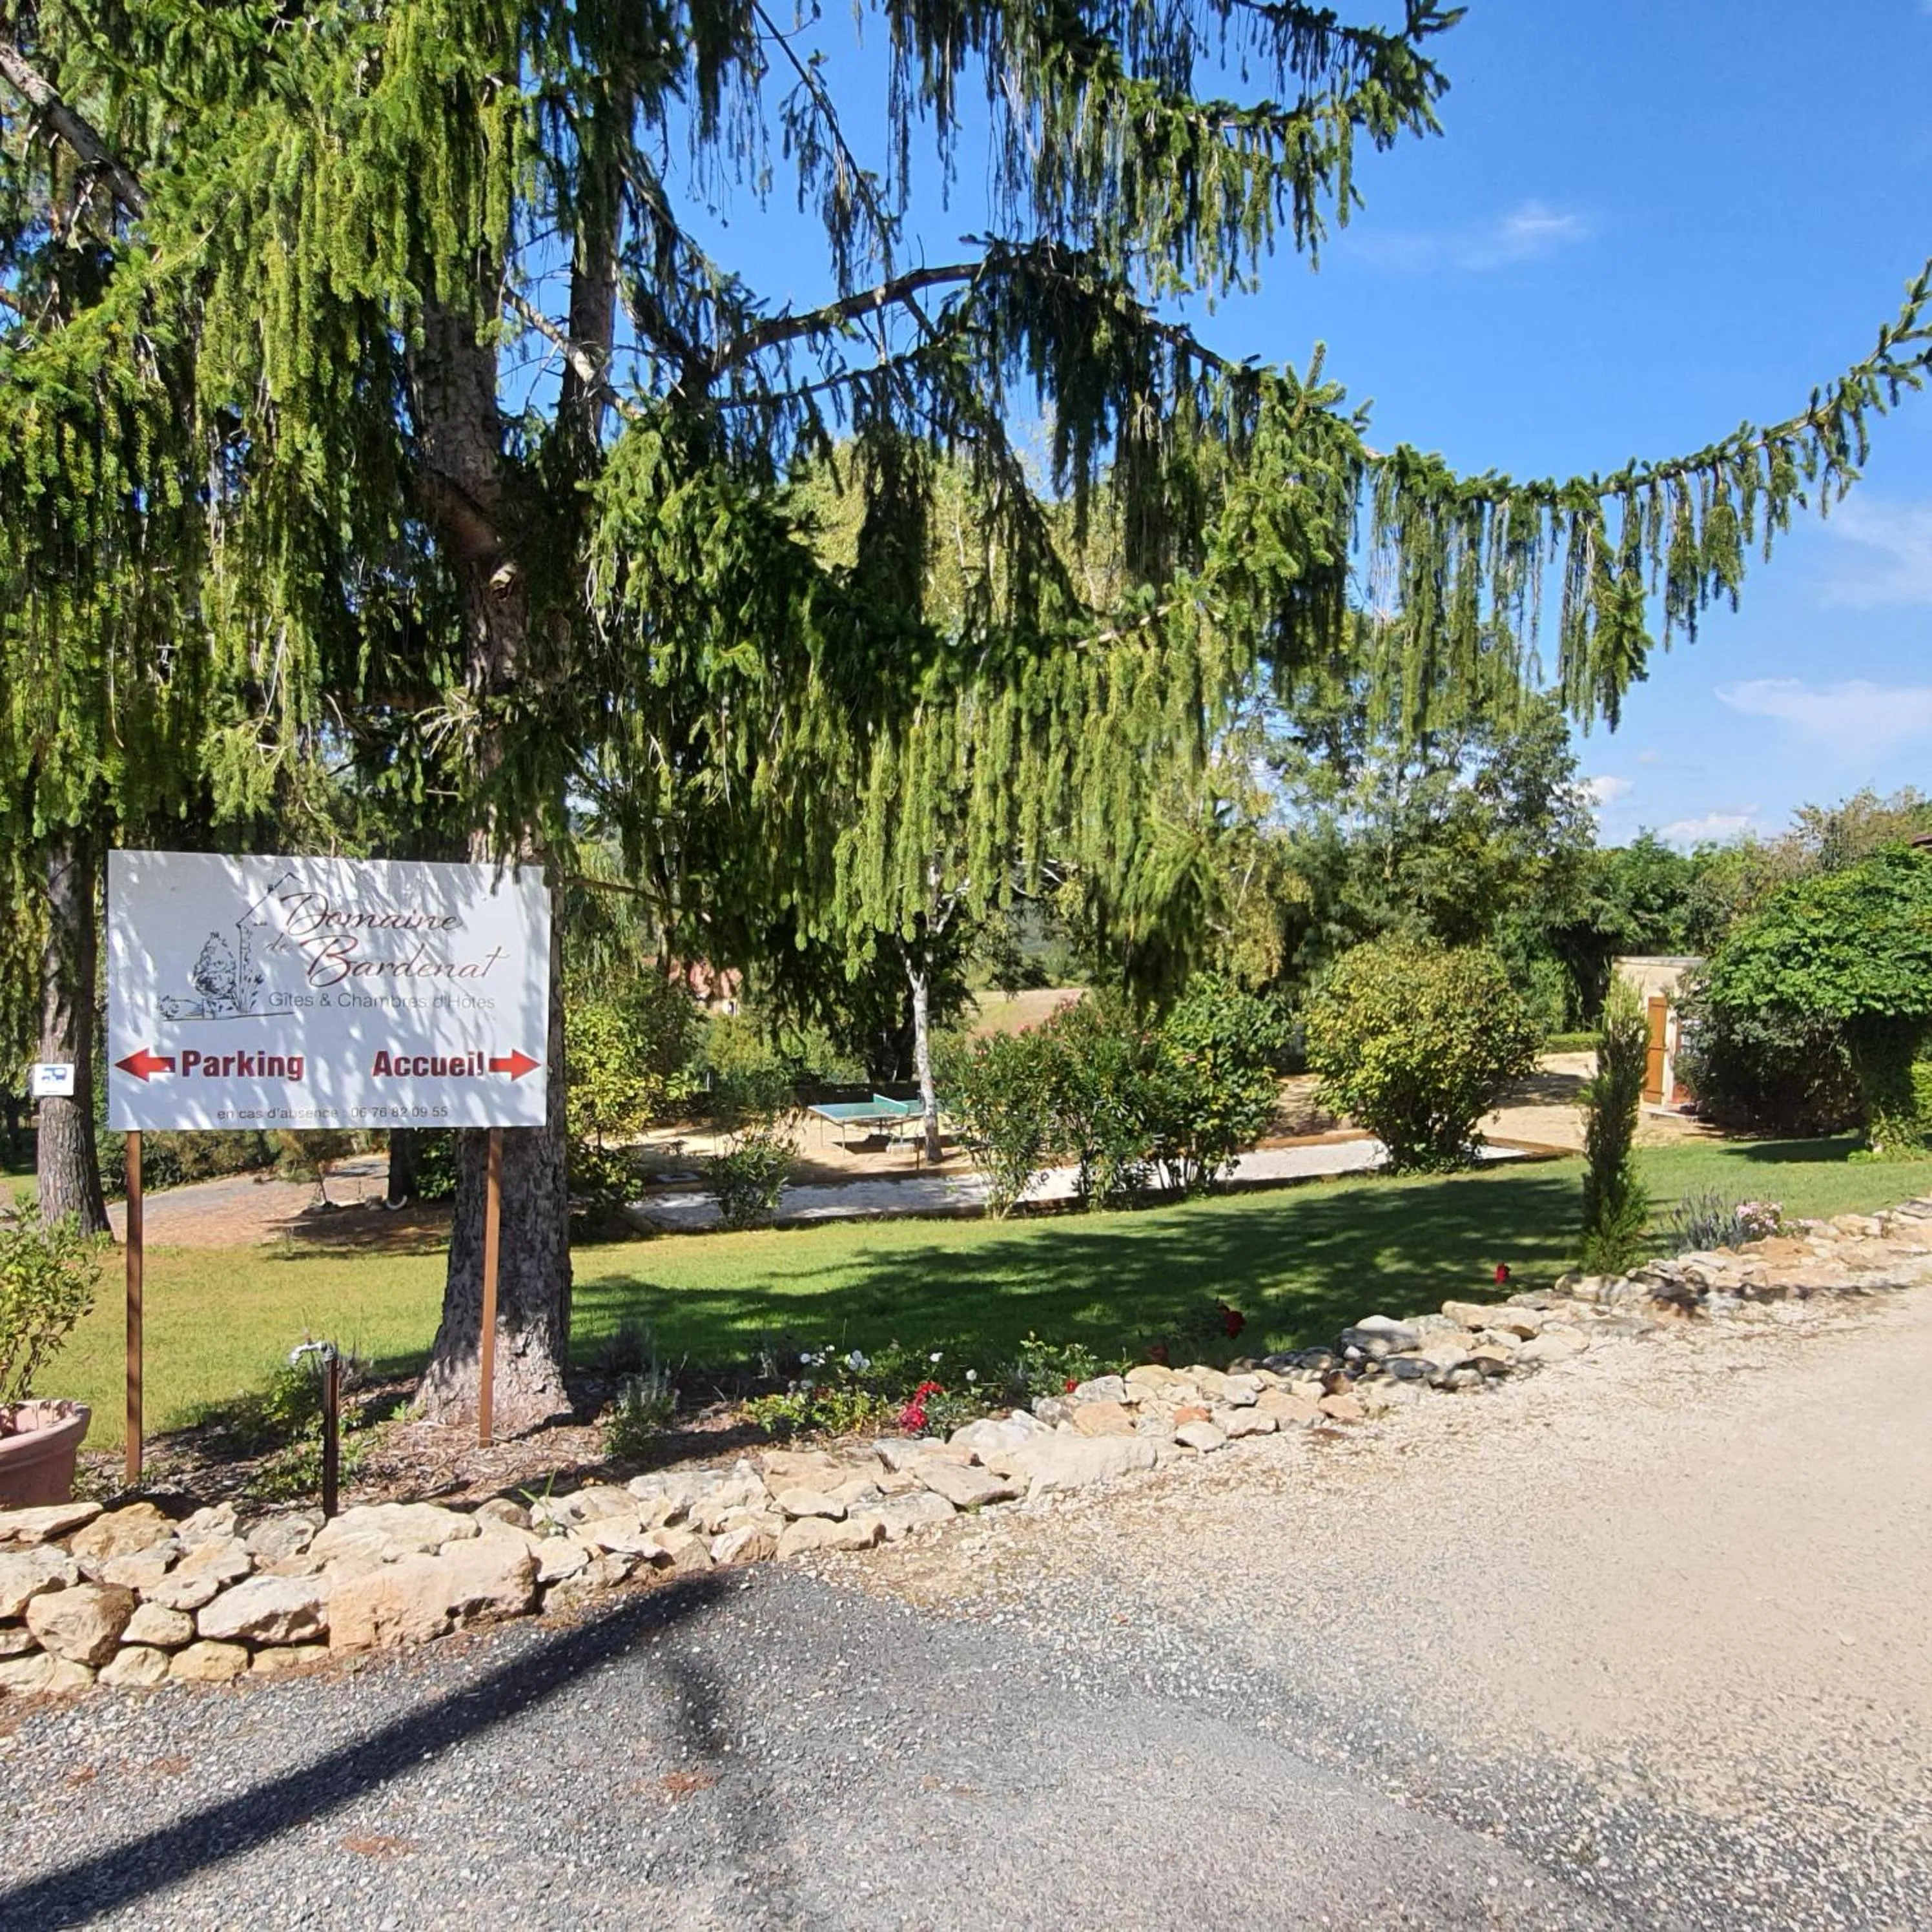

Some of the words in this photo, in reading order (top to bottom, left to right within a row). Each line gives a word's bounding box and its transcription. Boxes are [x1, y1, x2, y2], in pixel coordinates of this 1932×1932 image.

[280, 892, 464, 935] Domaine
[298, 934, 509, 987] Bardenat
[269, 991, 314, 1007] Gîtes
[320, 992, 331, 1007] &
[338, 992, 427, 1008] Chambres
[181, 1050, 304, 1082] Parking
[372, 1051, 484, 1076] Accueil
[217, 1110, 234, 1119] en
[239, 1110, 263, 1119] cas
[351, 1107, 366, 1118] 06
[391, 1107, 407, 1117] 82
[412, 1106, 427, 1117] 09
[432, 1106, 448, 1117] 55
